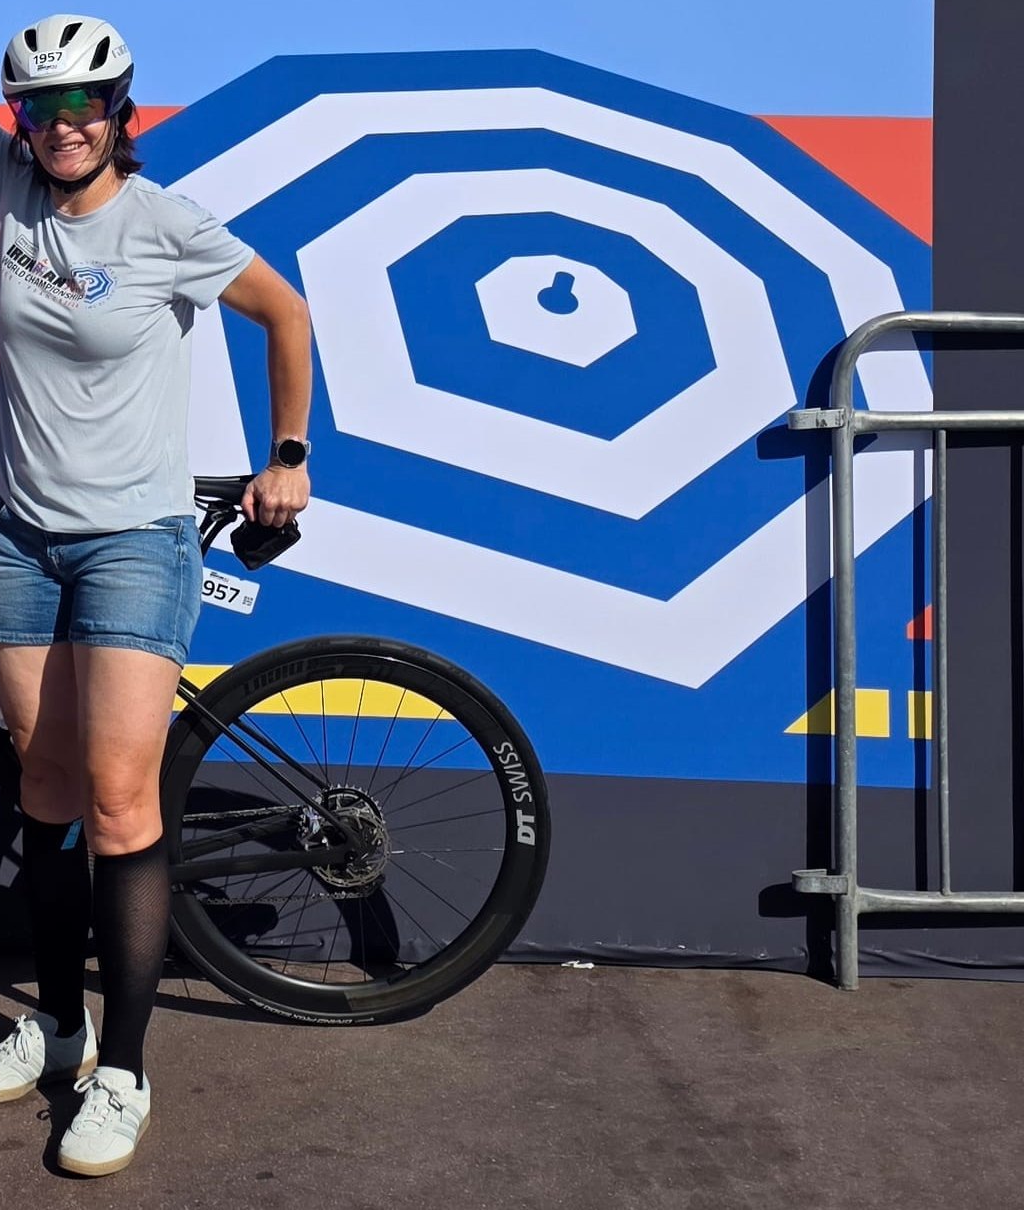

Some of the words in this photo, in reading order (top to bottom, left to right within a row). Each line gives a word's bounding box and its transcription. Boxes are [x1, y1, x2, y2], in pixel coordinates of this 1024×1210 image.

[32, 51, 64, 65] 1957
[2, 255, 26, 278] WORLD
[24, 273, 84, 302] CHAMPIONSHIP
[201, 579, 241, 603] 957
[492, 741, 532, 802] SWISS
[516, 809, 536, 846] DT
